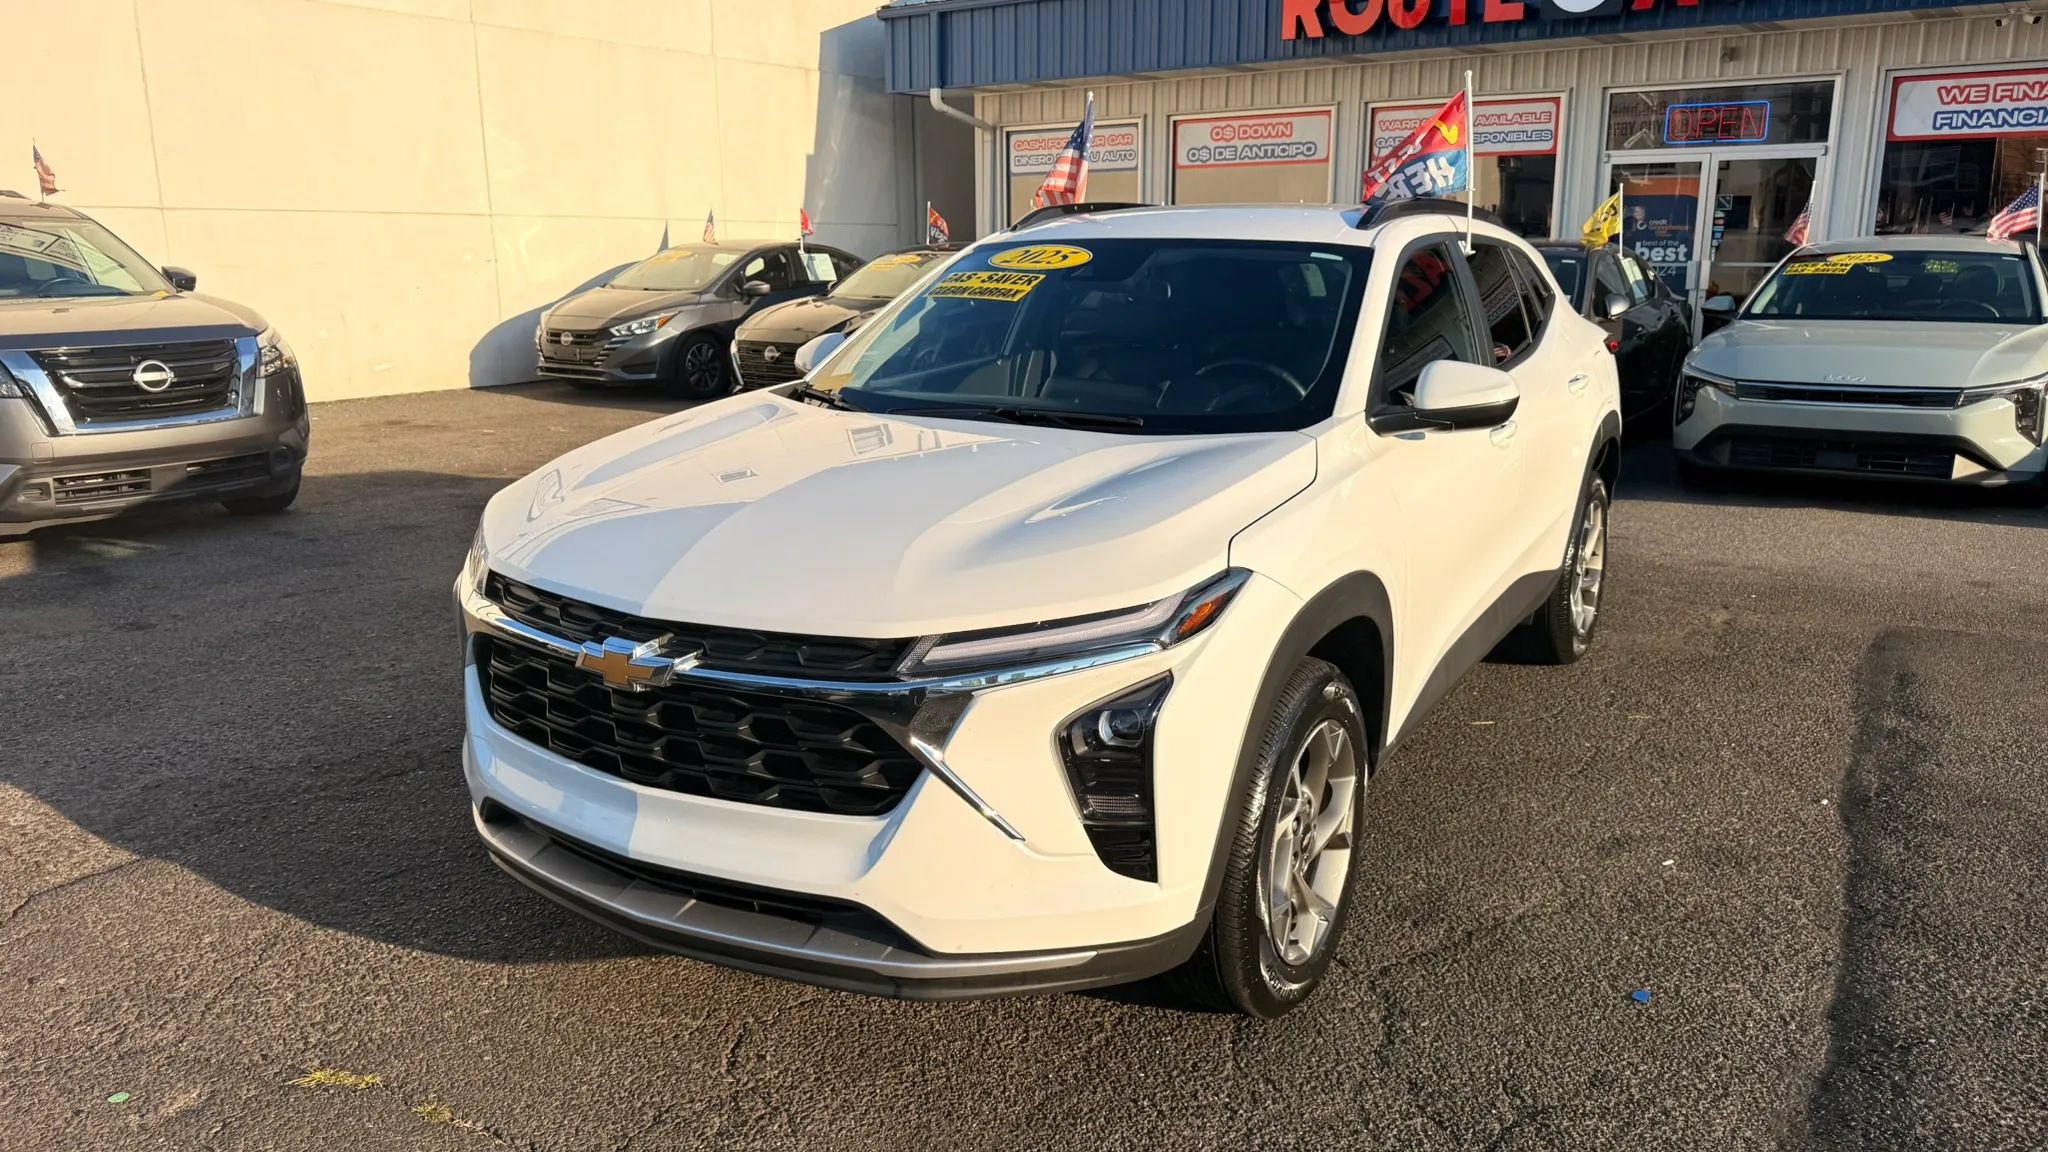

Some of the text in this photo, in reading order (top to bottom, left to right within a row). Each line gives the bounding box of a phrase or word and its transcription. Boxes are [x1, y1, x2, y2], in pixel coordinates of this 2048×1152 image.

[1937, 84, 1990, 105] WE
[1474, 111, 1552, 127] AVAILABLE
[1669, 106, 1766, 141] OPEN
[1238, 121, 1293, 139] DOWN
[1014, 139, 1046, 151] CASH
[1107, 133, 1133, 146] CAR
[1014, 153, 1055, 167] DINERO
[1102, 149, 1136, 162] AUTO
[1213, 145, 1238, 162] DE
[1239, 141, 1317, 160] ANTICIPO
[1003, 249, 1081, 264] 2025
[1635, 241, 1688, 261] best
